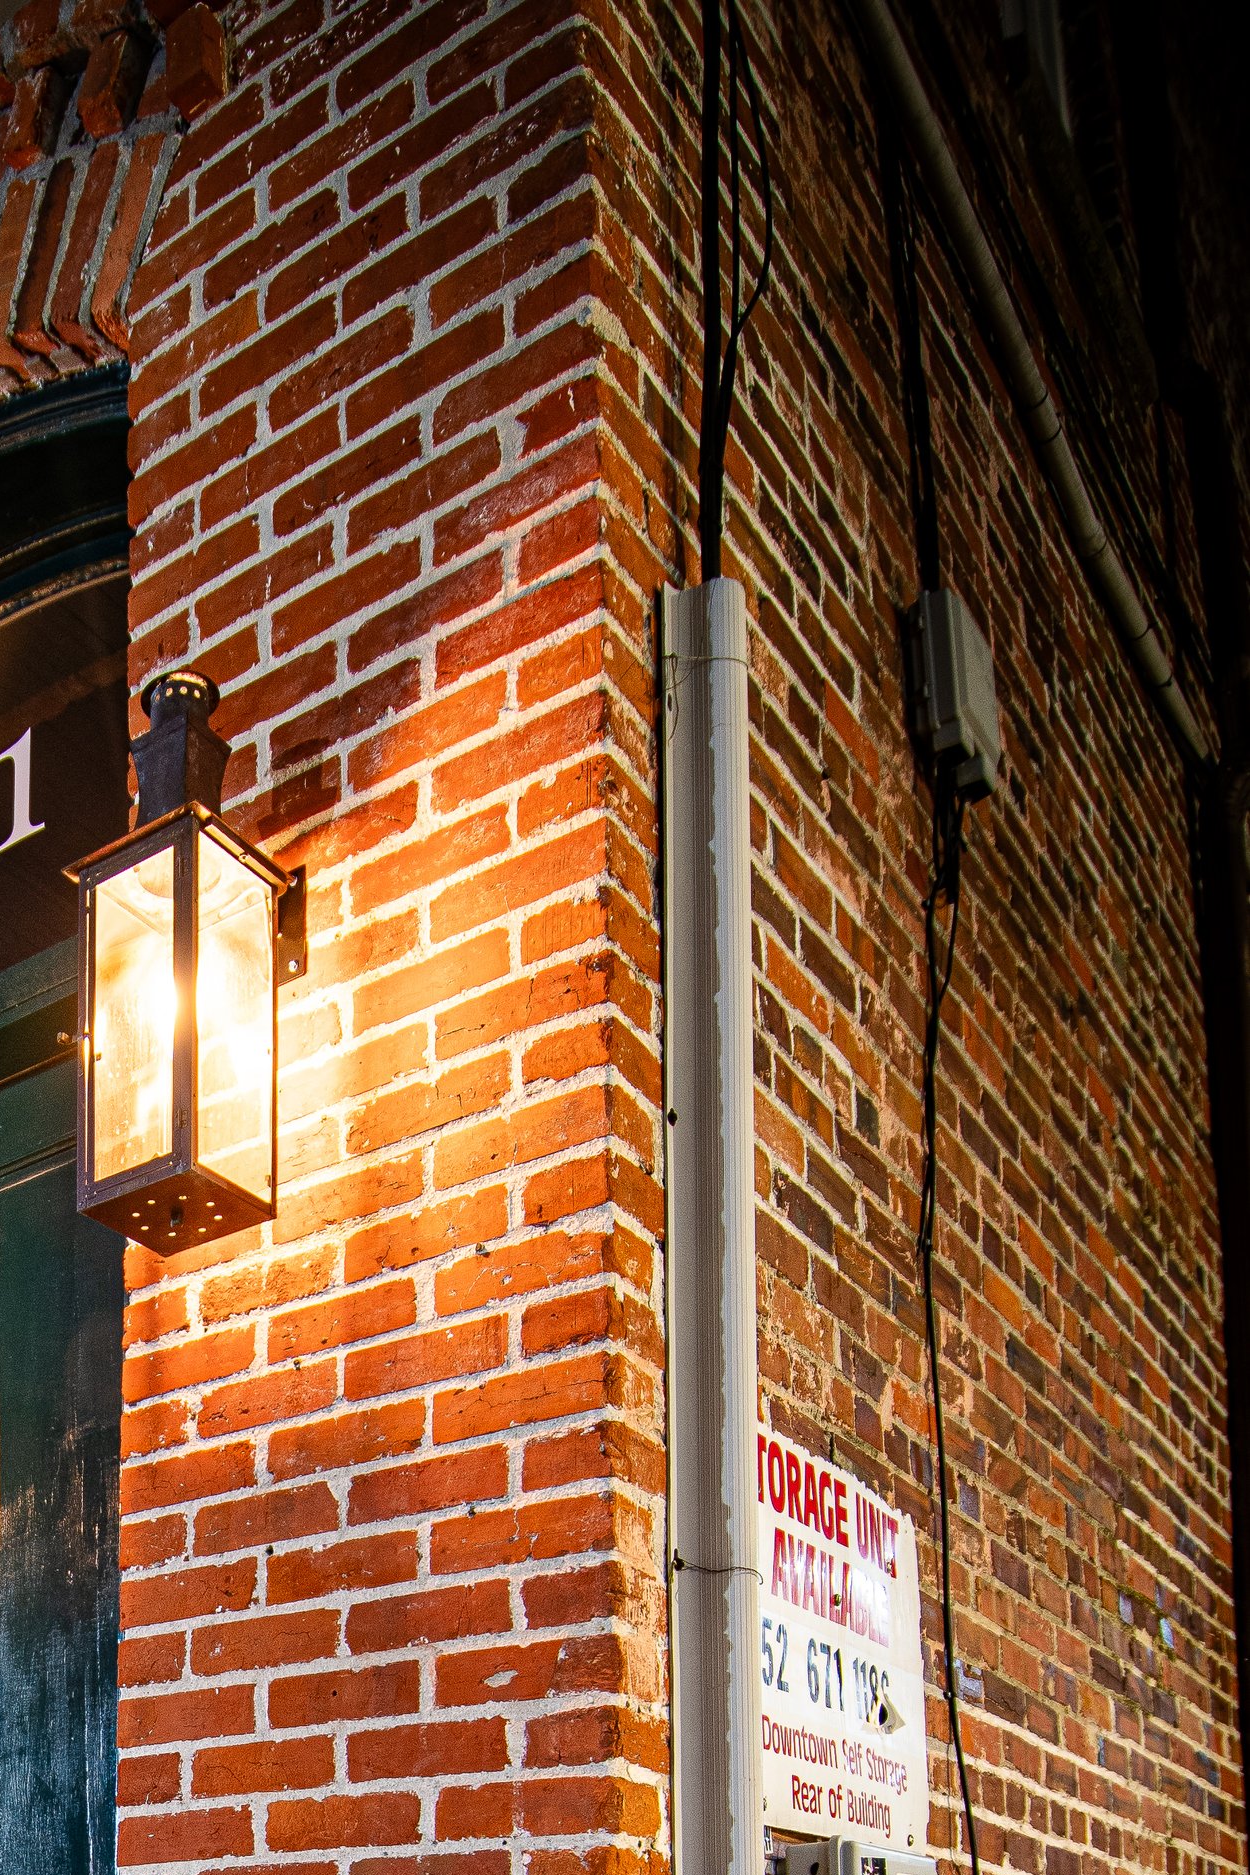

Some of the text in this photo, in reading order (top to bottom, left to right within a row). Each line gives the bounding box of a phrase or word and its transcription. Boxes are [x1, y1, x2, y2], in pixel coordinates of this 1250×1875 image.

[771, 1526, 890, 1649] AVAILABLE
[806, 1637, 845, 1712] 671
[761, 1713, 908, 1797] Downtown Self Storage
[792, 1774, 891, 1840] Rear of Building
